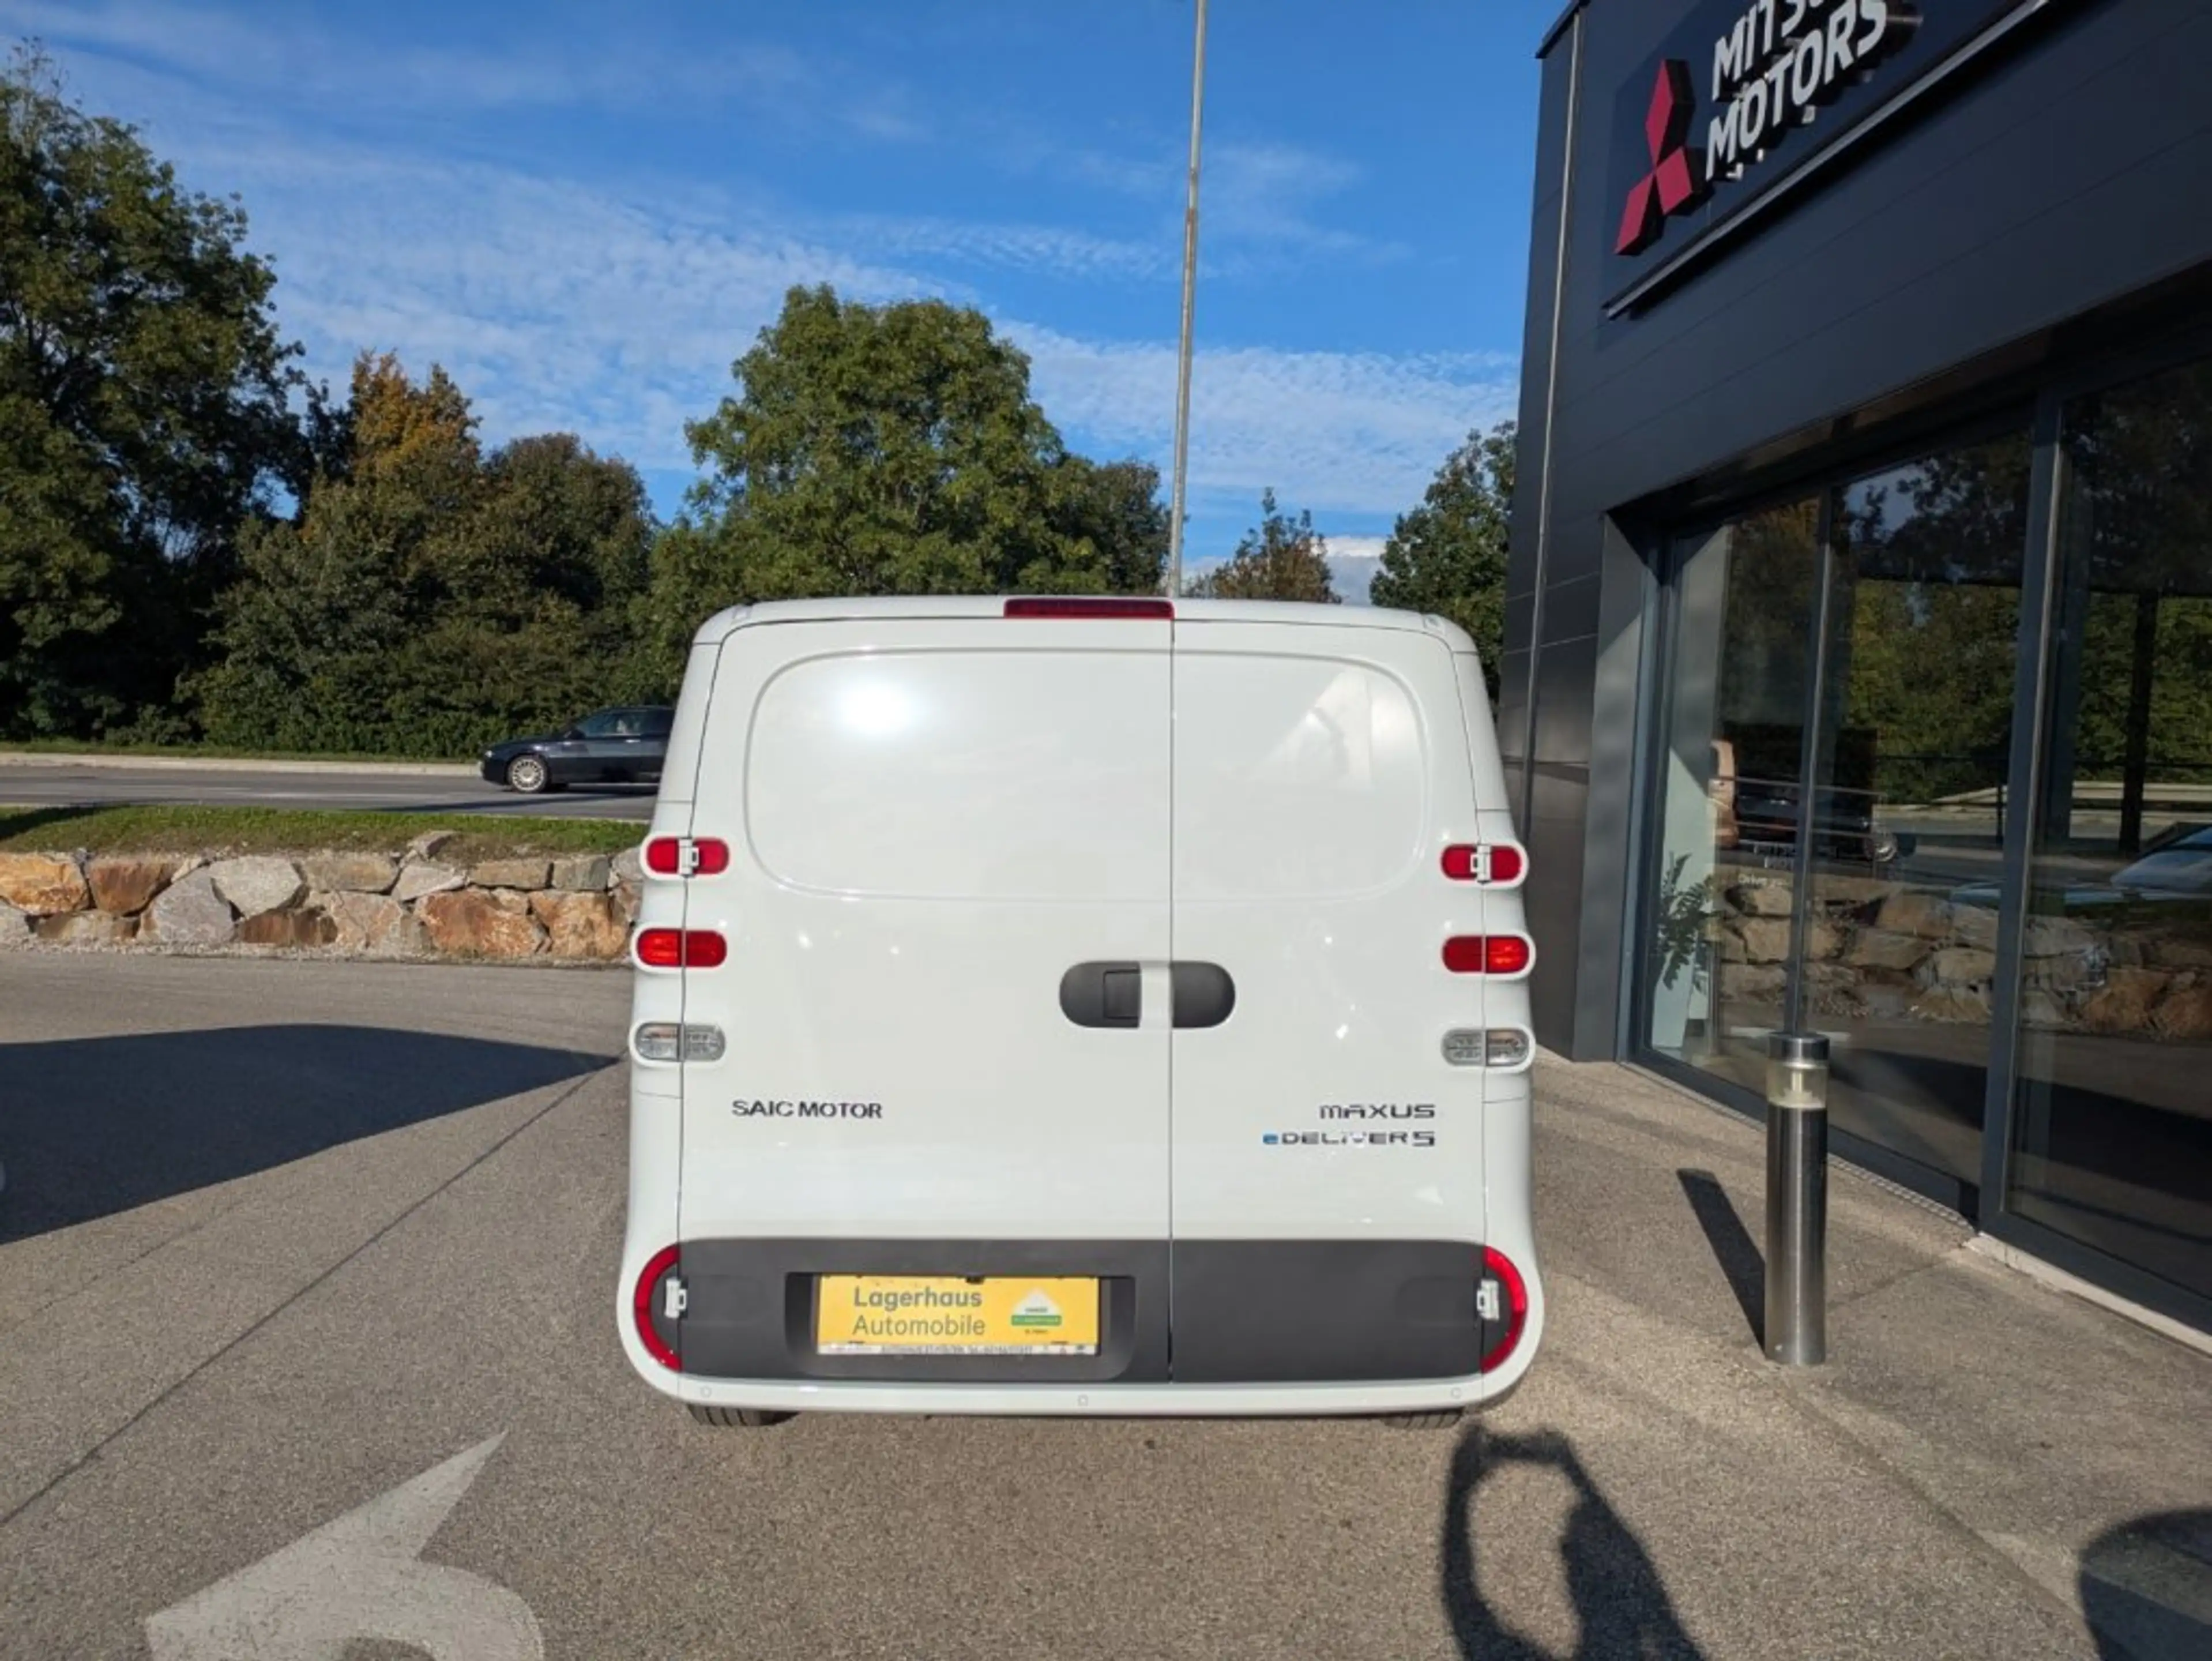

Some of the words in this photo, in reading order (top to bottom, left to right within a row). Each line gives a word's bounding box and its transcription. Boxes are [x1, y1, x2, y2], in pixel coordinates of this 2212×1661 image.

[1712, 0, 1823, 102] MITS
[1706, 0, 1887, 181] MOTORS
[731, 1099, 794, 1117] SAIC
[797, 1100, 883, 1119] MOTOR
[1319, 1104, 1435, 1119] MAXUS
[853, 1286, 983, 1311] Lagerhaus
[852, 1315, 986, 1336] Automobile
